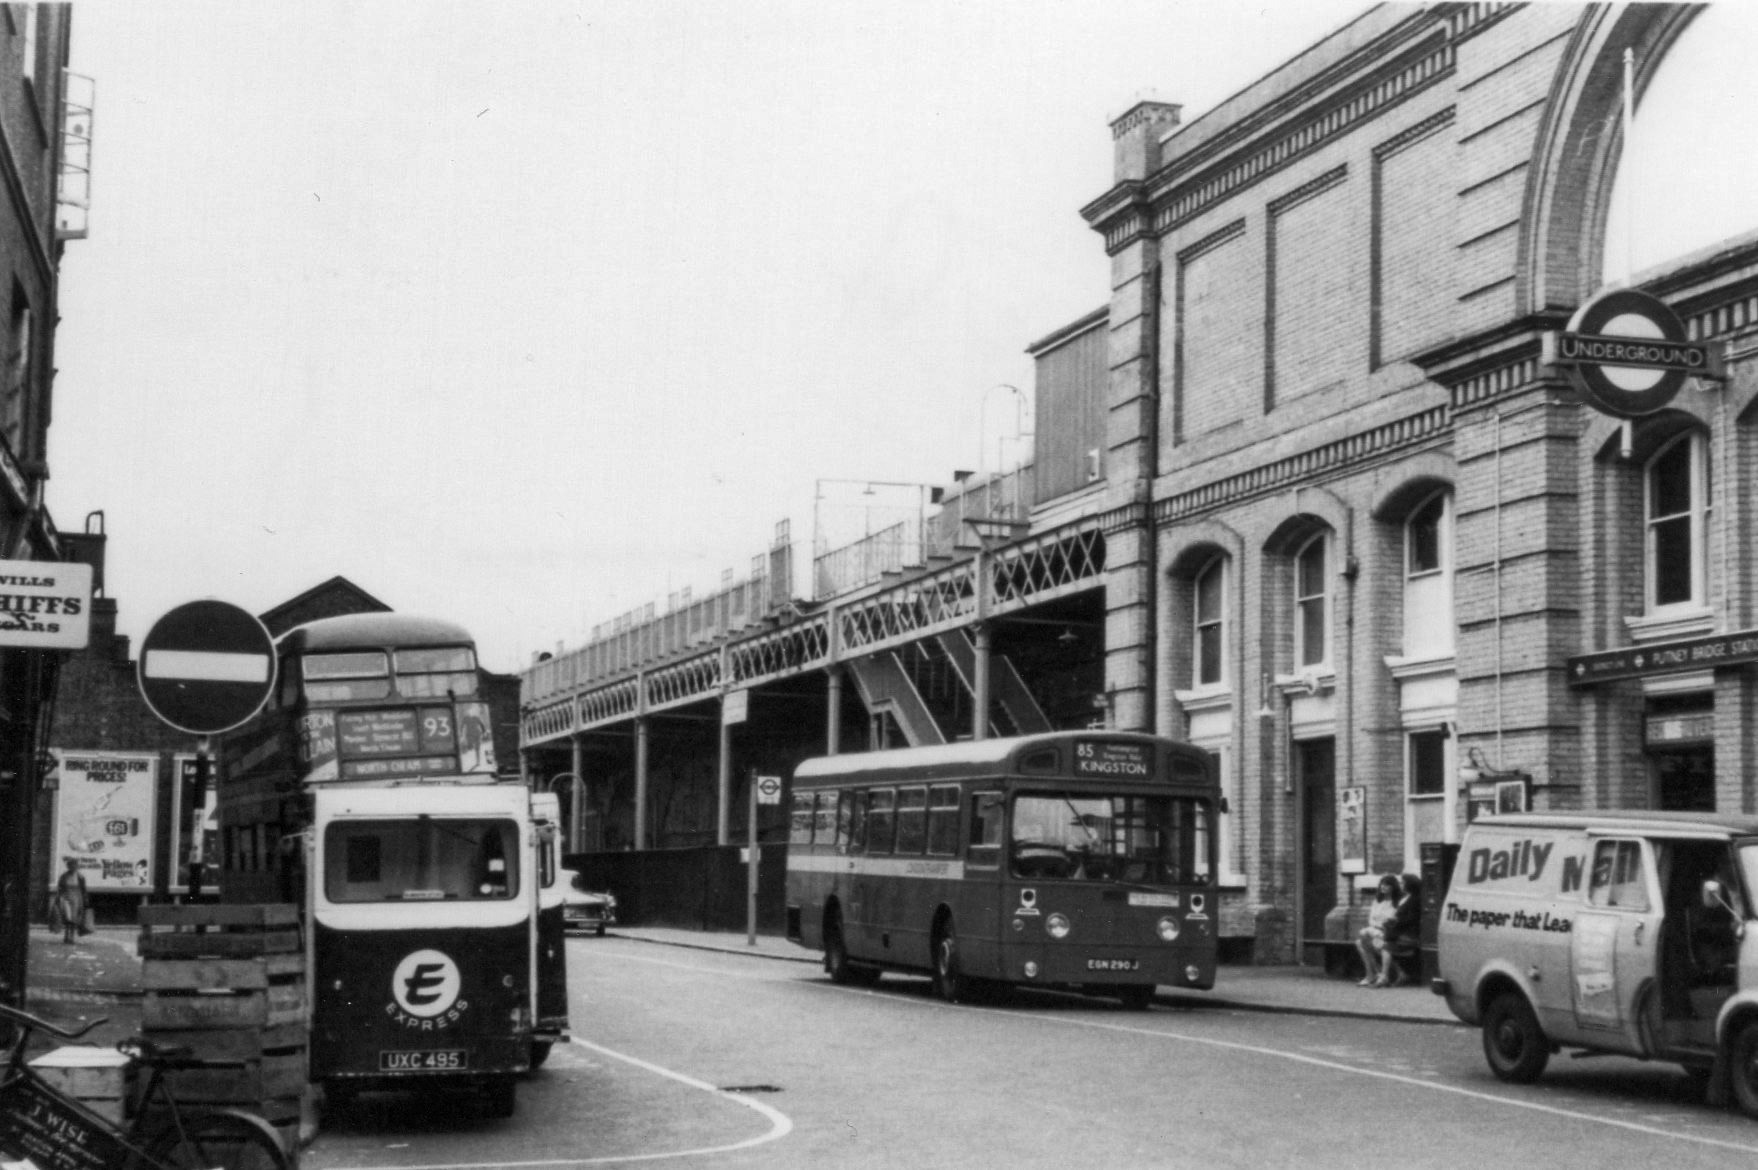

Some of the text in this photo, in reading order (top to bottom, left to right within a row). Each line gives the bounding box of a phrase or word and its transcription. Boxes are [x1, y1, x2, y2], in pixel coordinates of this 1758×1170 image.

[1562, 338, 1703, 367] UNDERGROUND
[1692, 642, 1726, 660] BRIDGE
[424, 718, 449, 737] 93
[1078, 743, 1094, 758] 85
[65, 761, 148, 772] RING ROUND FOR
[1081, 761, 1147, 775] KINGSTON
[1468, 840, 1553, 884] Daily
[1448, 903, 1468, 922] The
[1469, 906, 1510, 930] paper
[1513, 910, 1541, 930] that
[385, 999, 468, 1031] EXPRESS
[388, 1052, 459, 1068] UXC 495
